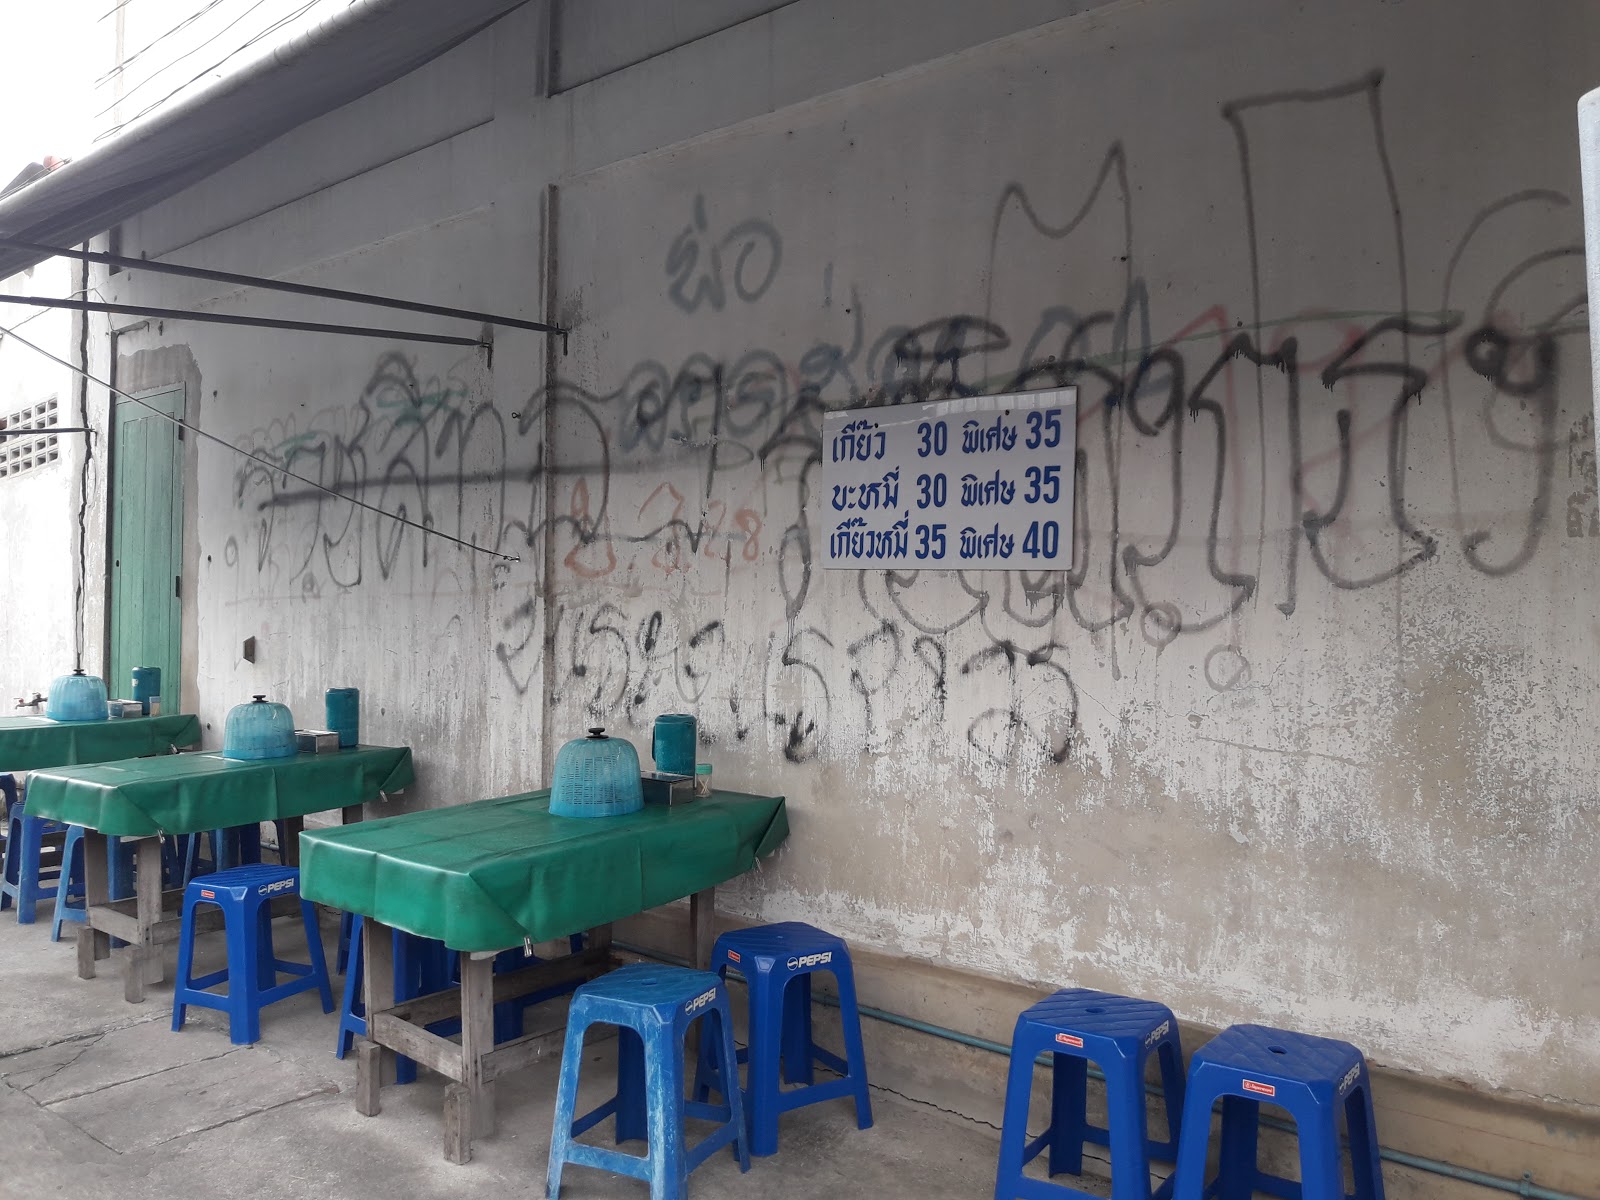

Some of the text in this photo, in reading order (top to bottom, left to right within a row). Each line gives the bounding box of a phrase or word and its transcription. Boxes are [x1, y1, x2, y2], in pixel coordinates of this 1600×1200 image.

[832, 409, 1062, 463] เกี๊ยว 30 พิเศษ 35
[831, 465, 1061, 511] บะหมี่ 30 พิเศษ 35
[830, 509, 1060, 560] เกี๊ยวหมี่ 35 พิเศษ 40
[267, 877, 295, 894] PEPSI
[798, 951, 833, 968] PEPSI
[692, 987, 717, 1012] PEPSI
[1150, 1019, 1169, 1045] PEPSI
